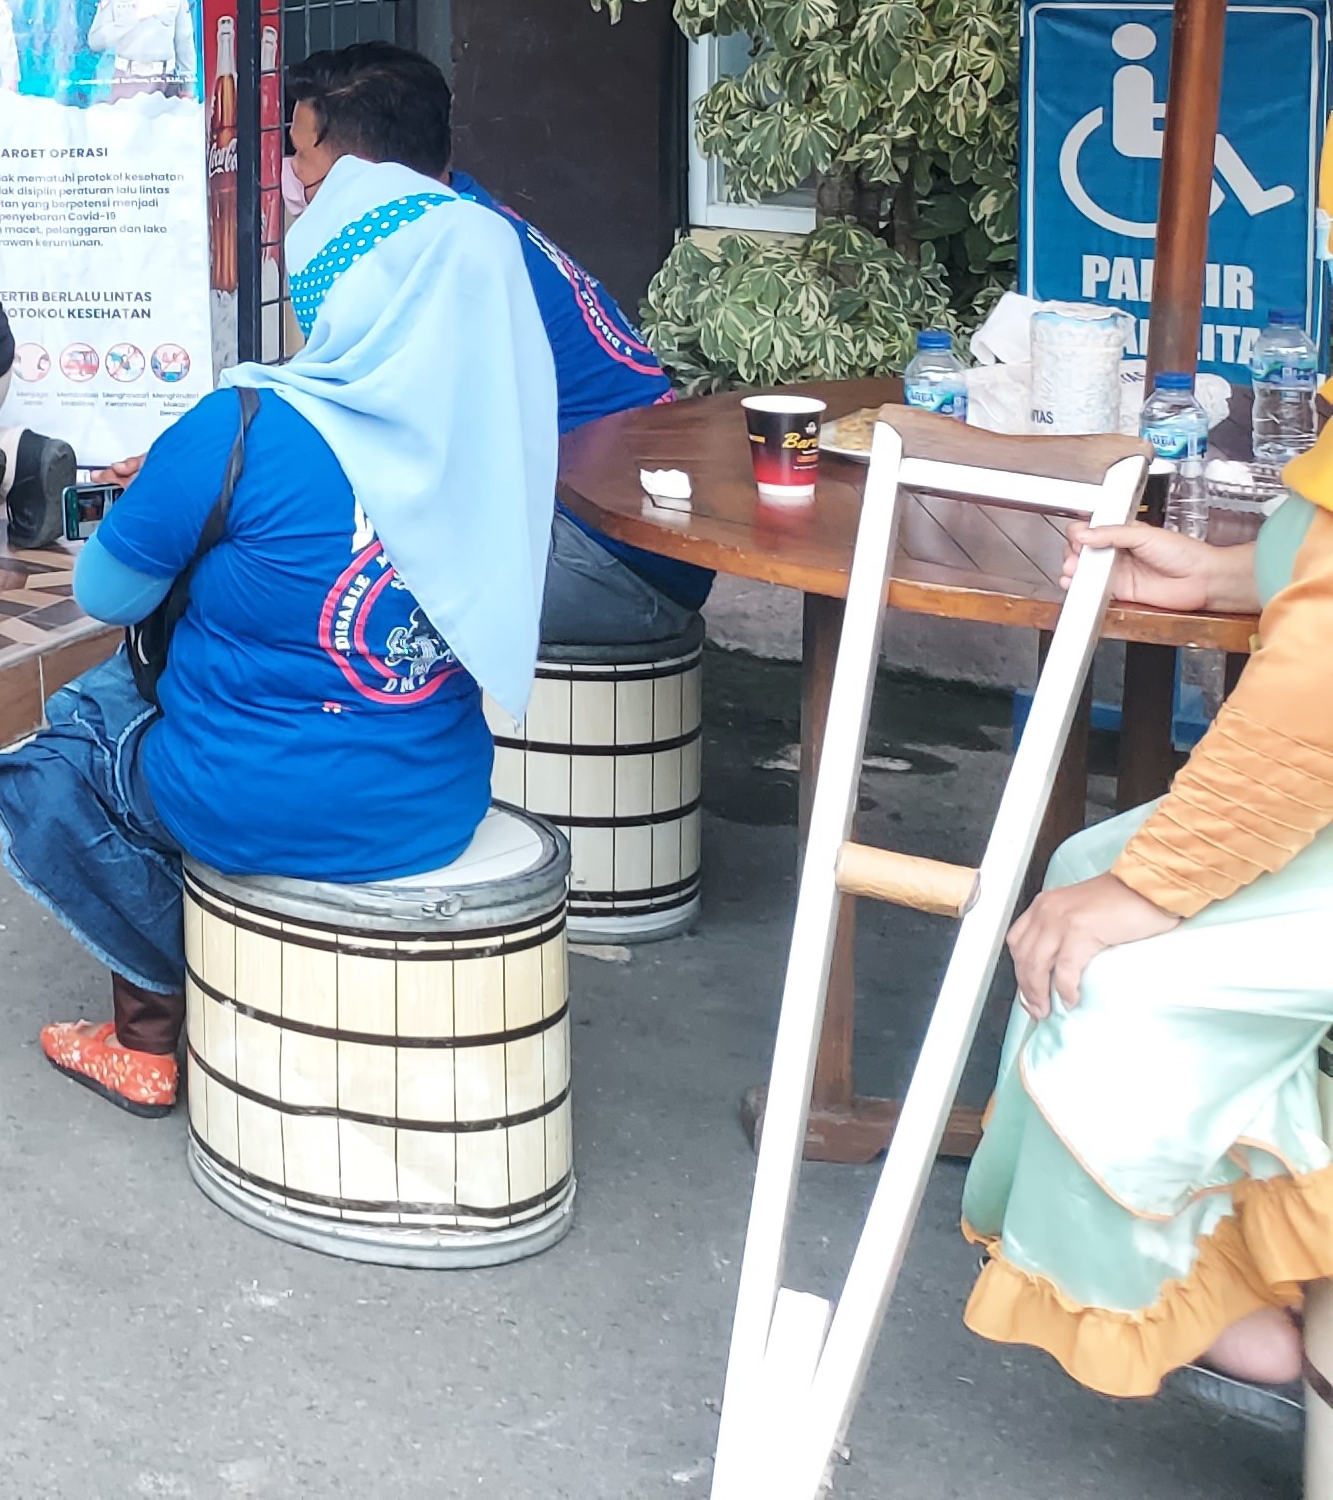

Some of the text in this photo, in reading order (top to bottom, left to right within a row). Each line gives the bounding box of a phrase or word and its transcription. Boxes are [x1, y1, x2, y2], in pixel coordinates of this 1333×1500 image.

[50, 148, 108, 159] OPERASI
[17, 173, 75, 183] mematuhi
[77, 173, 122, 185] protokol
[125, 172, 184, 182] kesehatan
[17, 185, 57, 198] disiplin
[59, 187, 114, 199] peraturan
[116, 185, 137, 195] lalu
[139, 184, 170, 195] lintas
[21, 201, 49, 212] yang
[52, 198, 111, 210] berpotensi
[113, 197, 159, 211] menjadi
[0, 211, 66, 224] penyebaran
[68, 211, 116, 221] Covid-19
[45, 224, 117, 237] pelanggaran
[120, 223, 141, 234] dan
[143, 223, 167, 234] laka
[36, 237, 104, 248] kerumunan.
[1082, 254, 1254, 311] PAIR
[42, 291, 100, 302] BERLALU
[104, 291, 152, 302] LINTAS
[6, 307, 152, 319] OTOKOL KESEHATAN
[334, 573, 372, 652] DISABLE
